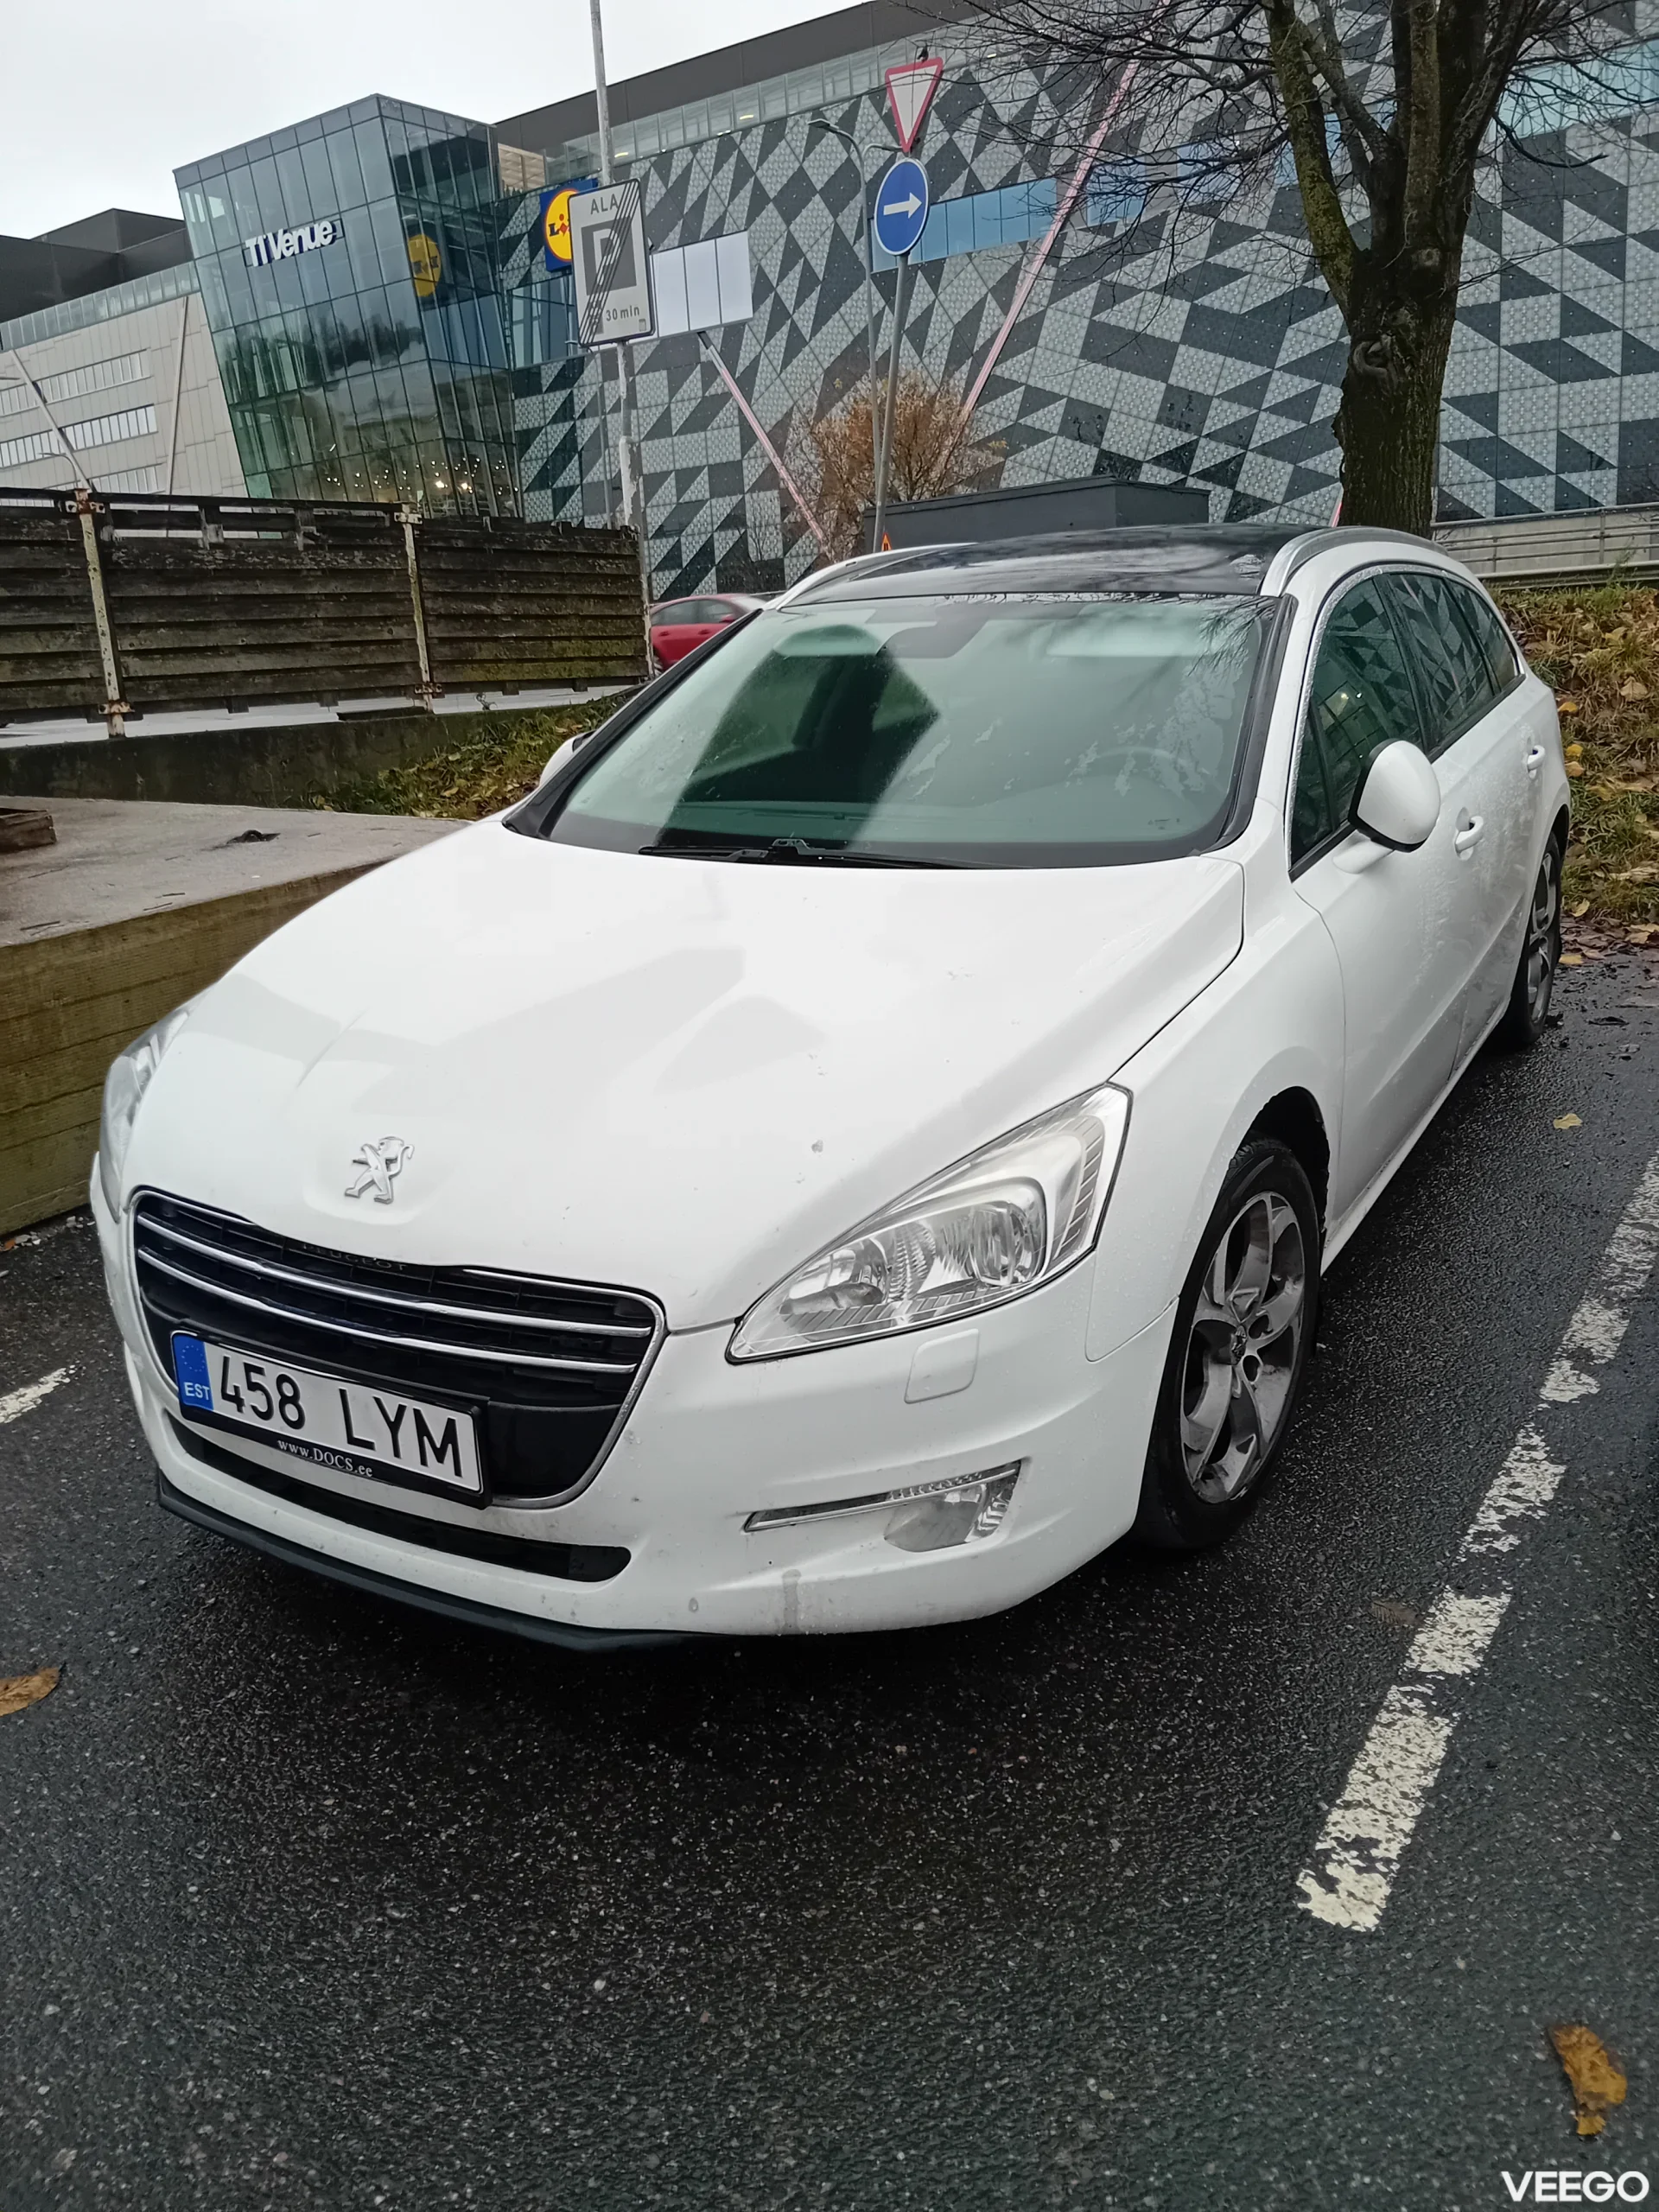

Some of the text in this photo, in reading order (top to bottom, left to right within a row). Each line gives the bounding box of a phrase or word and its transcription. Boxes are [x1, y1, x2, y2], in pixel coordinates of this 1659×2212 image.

[590, 194, 619, 215] ALA
[245, 221, 334, 267] T1 Venue
[606, 305, 640, 321] 30 min
[185, 1382, 211, 1401] EST
[220, 1355, 464, 1478] 458 LYM
[277, 1440, 373, 1478] www.DOCS.ee
